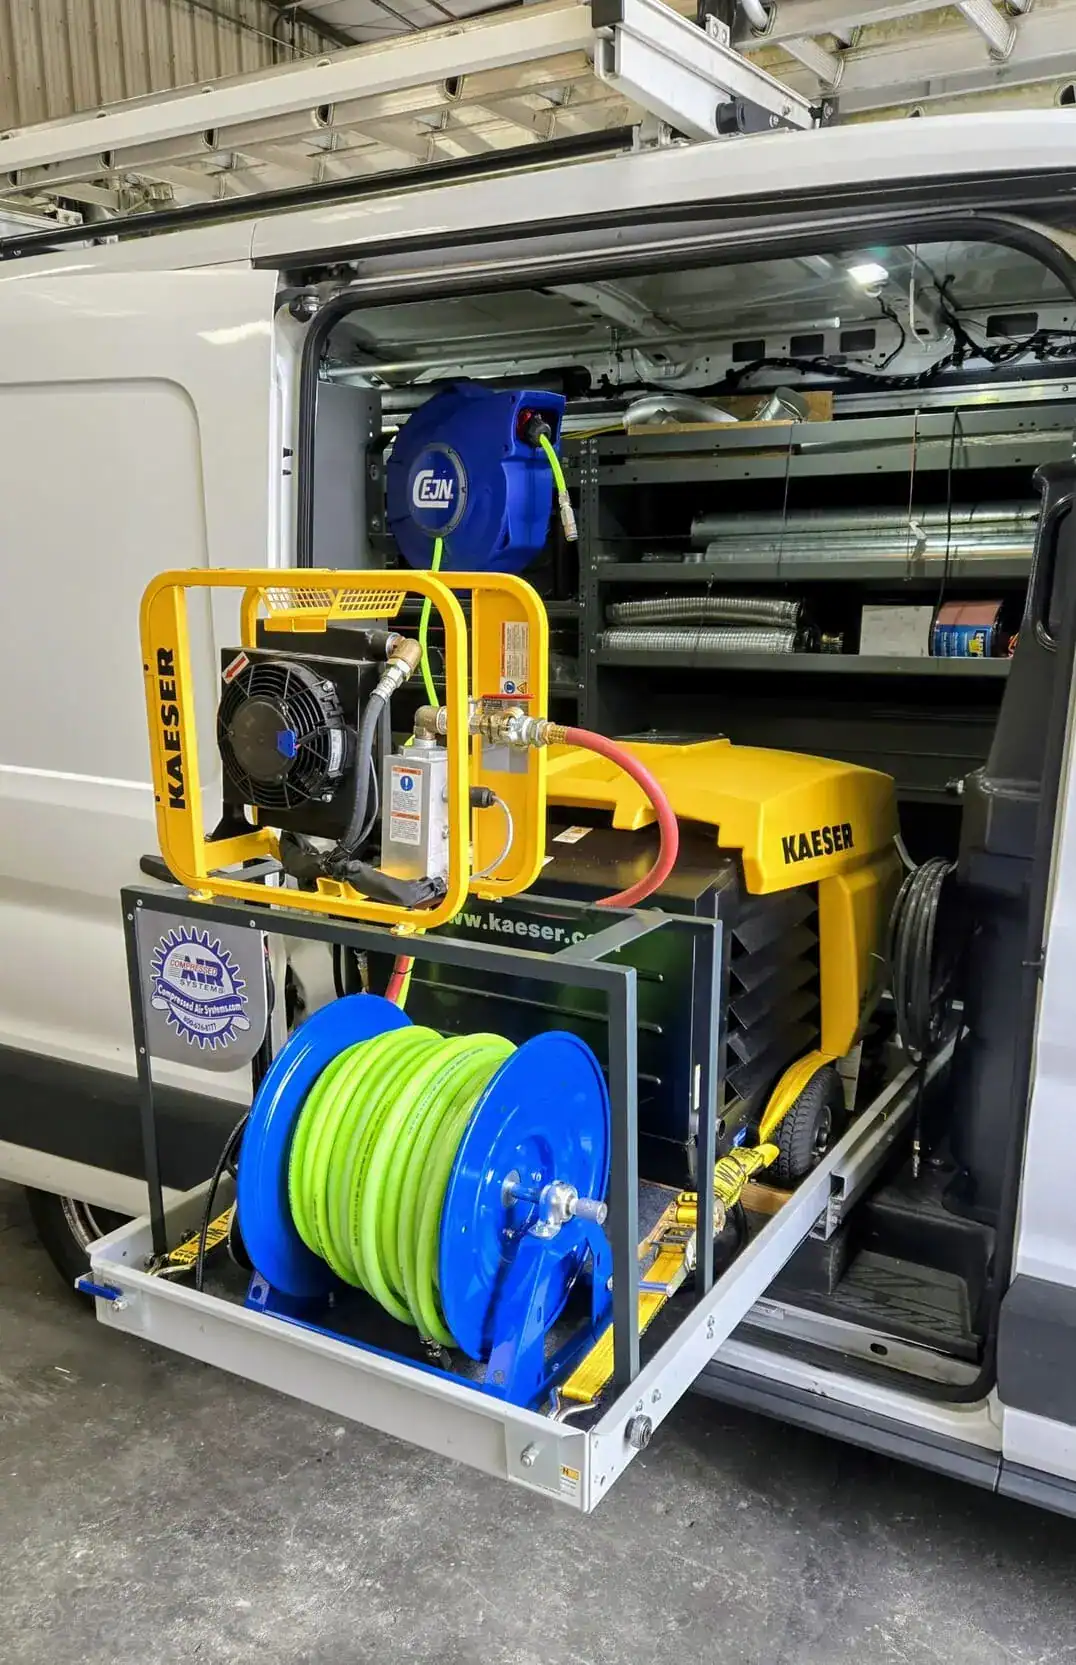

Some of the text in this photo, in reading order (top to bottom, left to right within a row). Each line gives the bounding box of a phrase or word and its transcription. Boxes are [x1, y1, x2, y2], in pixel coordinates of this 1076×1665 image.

[412, 469, 454, 508] CEJN
[156, 647, 186, 809] KAESER
[781, 822, 855, 865] KAESER
[170, 958, 218, 977] COMPRESSED
[180, 978, 225, 994] SYSTEMS
